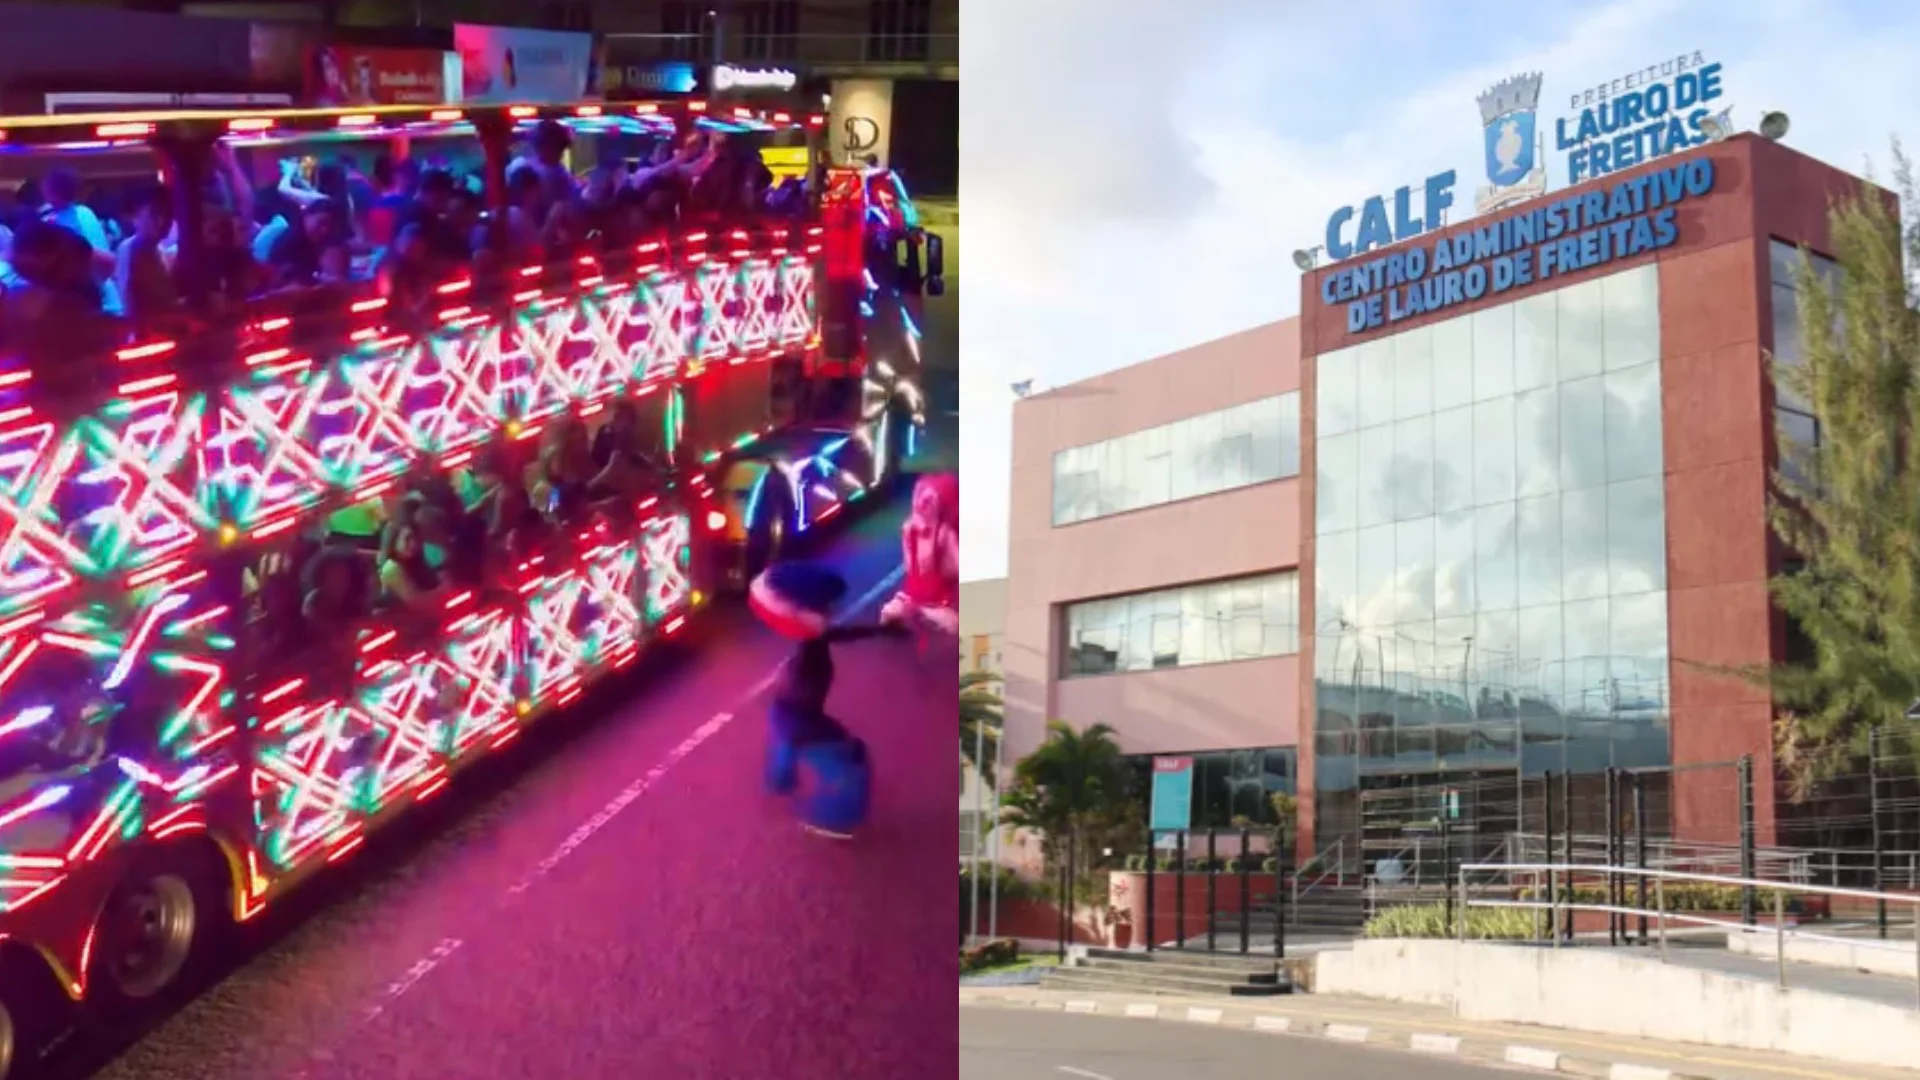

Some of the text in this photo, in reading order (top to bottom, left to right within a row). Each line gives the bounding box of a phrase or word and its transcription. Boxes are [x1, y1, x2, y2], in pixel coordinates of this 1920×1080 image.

[1556, 62, 1723, 151] LAURO DE
[1571, 50, 1705, 109] PREFEITURA
[1568, 109, 1712, 185] FREITAS
[1321, 157, 1714, 305] CENTRO ADMINISTRATIVO
[1325, 169, 1457, 260] CALF
[1347, 207, 1679, 333] DE LAURO DE FREITAS
